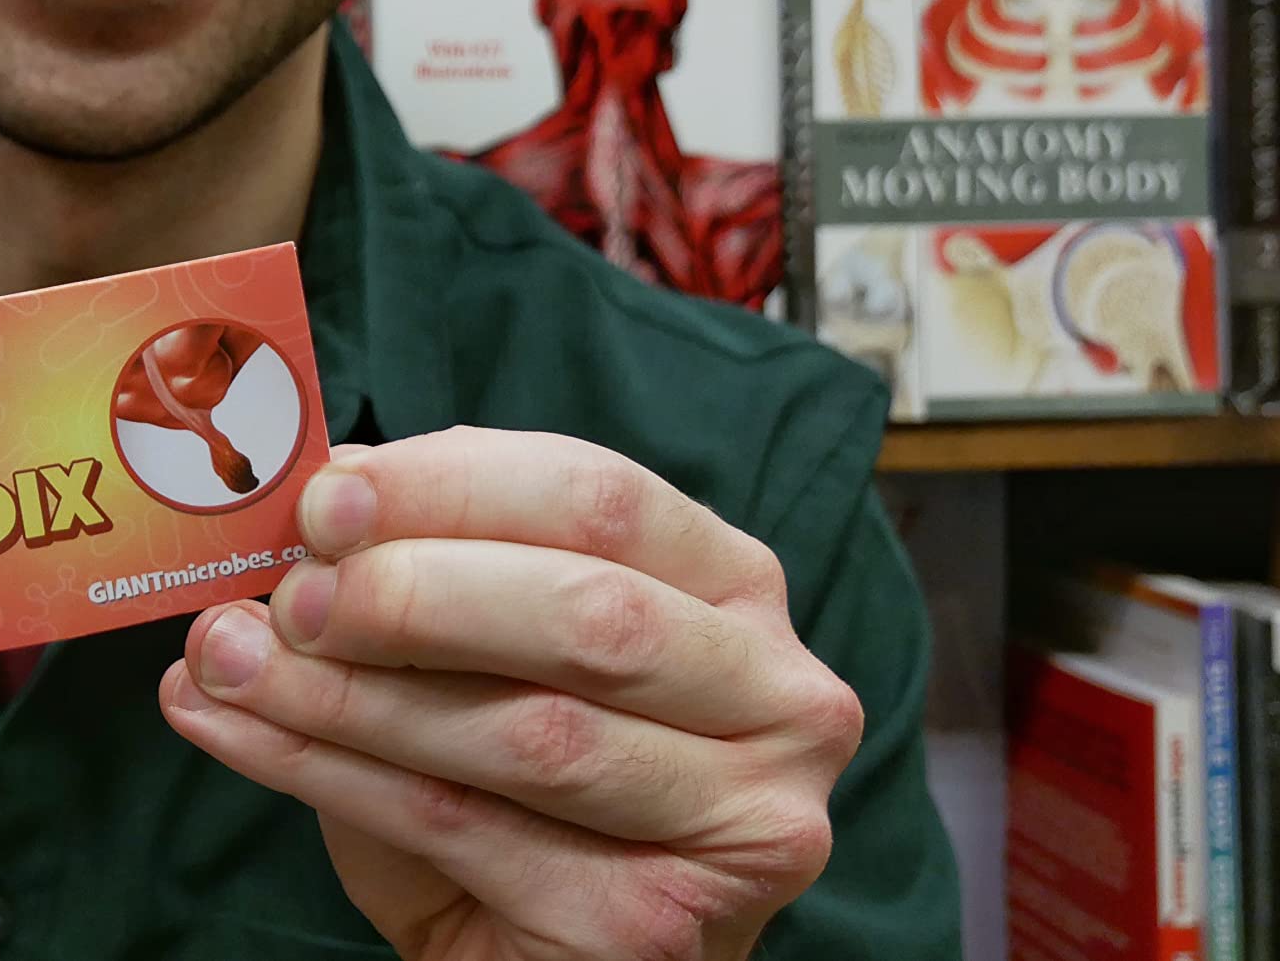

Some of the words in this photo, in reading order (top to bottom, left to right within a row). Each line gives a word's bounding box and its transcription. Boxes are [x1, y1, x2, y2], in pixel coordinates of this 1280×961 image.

[900, 123, 1131, 164] ANATOMY
[841, 163, 1048, 207] MOVING
[1058, 161, 1184, 203] BODY
[87, 544, 309, 604] GIANTmicrobes.co
